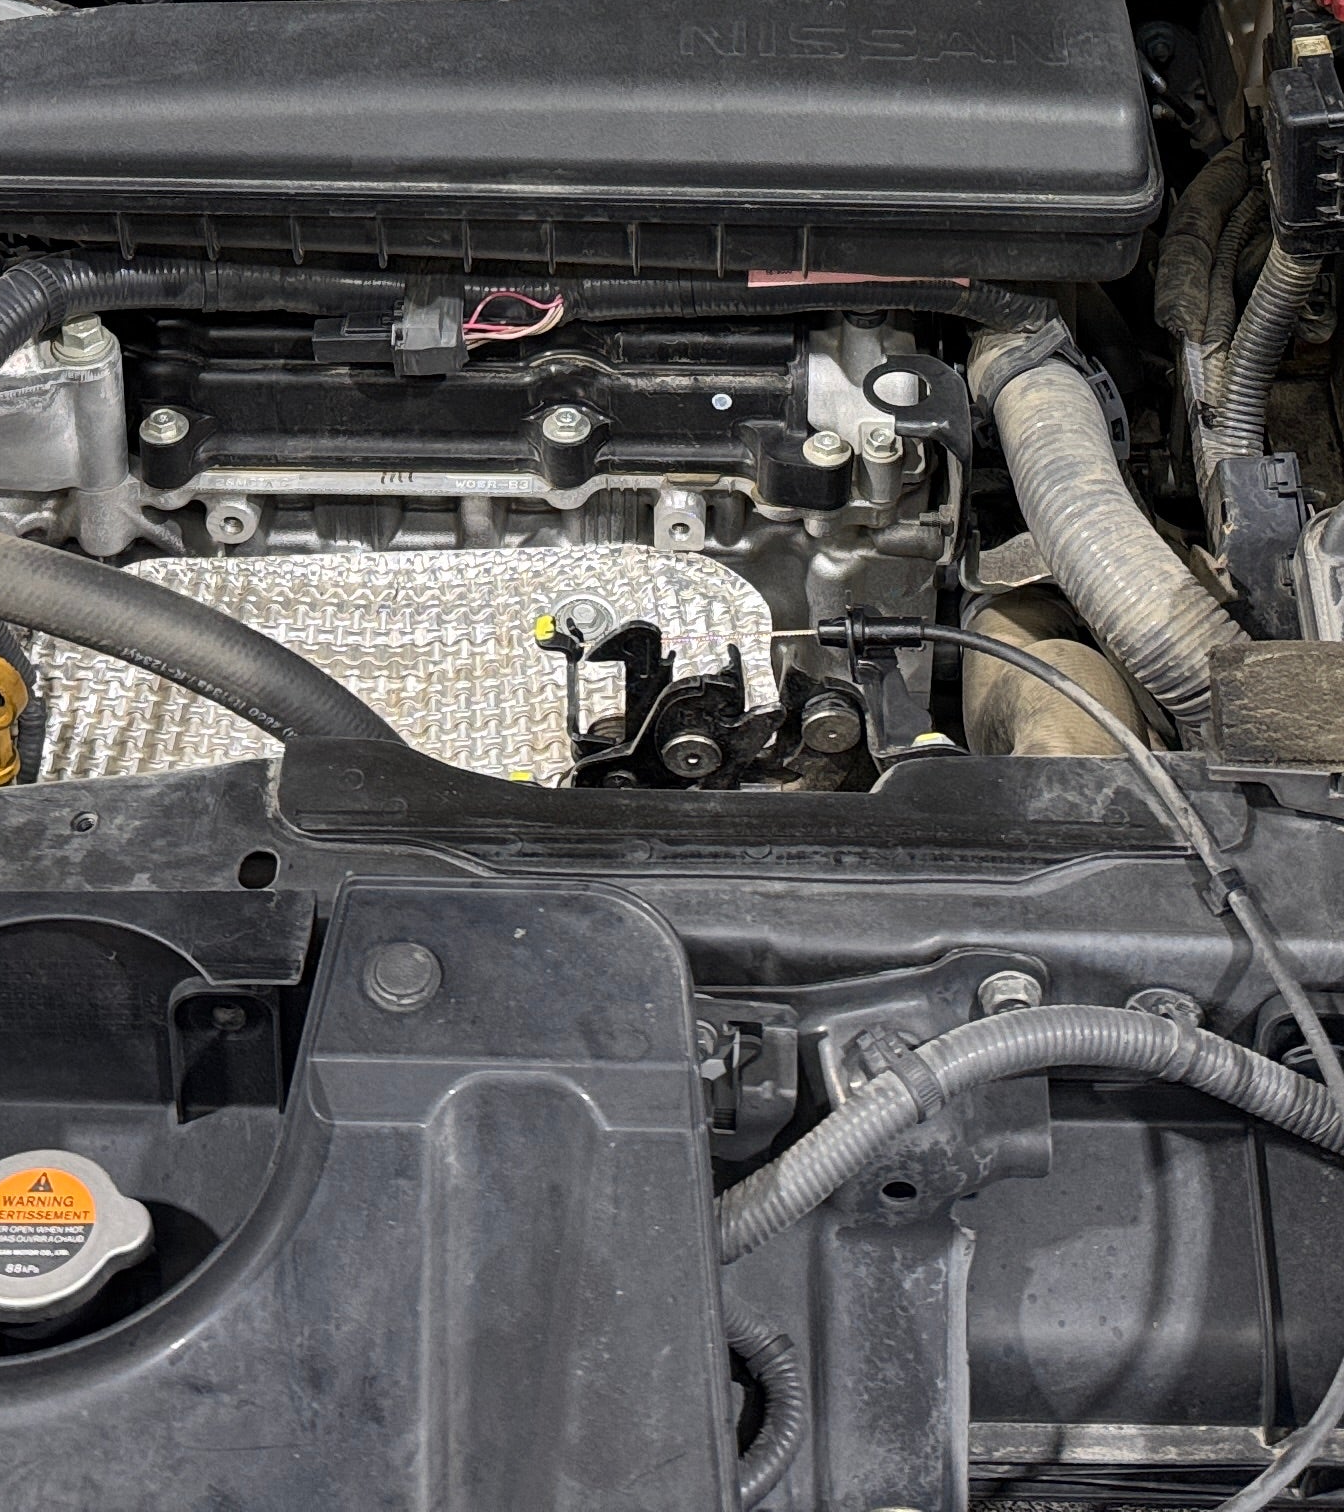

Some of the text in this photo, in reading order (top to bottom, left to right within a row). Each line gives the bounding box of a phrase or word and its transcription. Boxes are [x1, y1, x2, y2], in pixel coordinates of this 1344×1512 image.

[680, 21, 1070, 65] NISSAN
[2, 1195, 74, 1207] WARNING
[9, 1225, 34, 1234] OPEN
[36, 1226, 64, 1234] WHEN
[16, 1235, 47, 1243] OUVRIR
